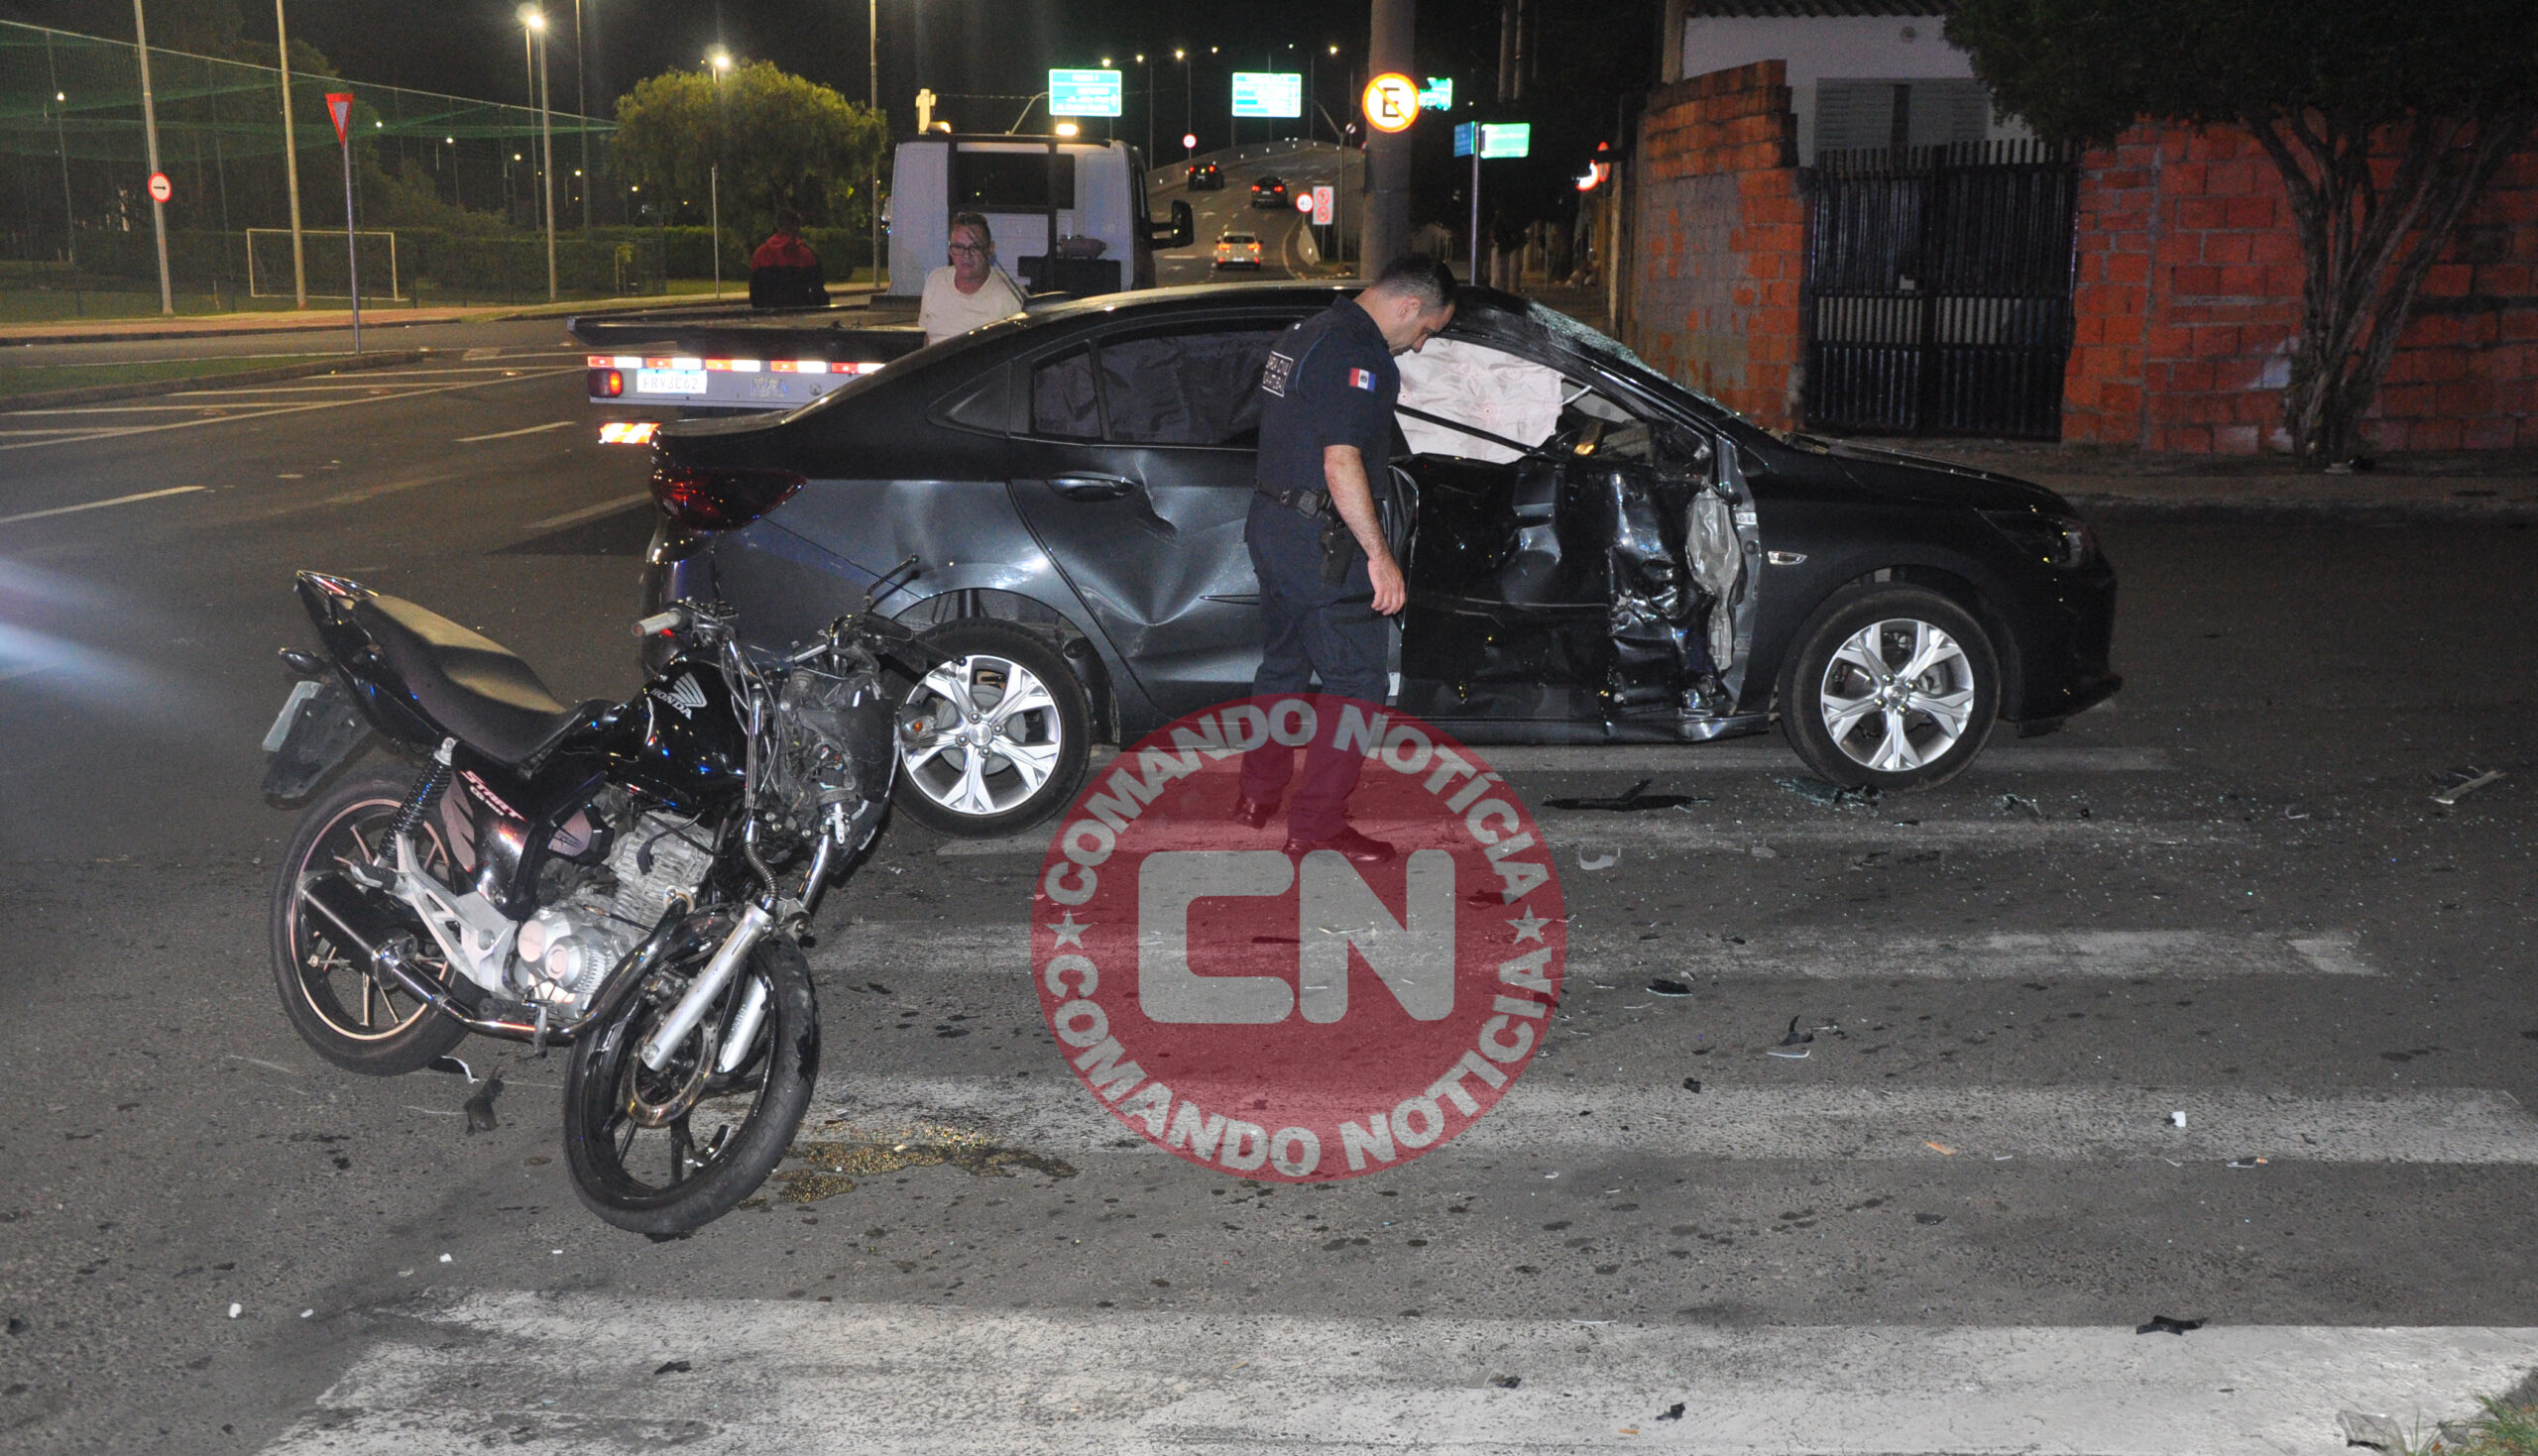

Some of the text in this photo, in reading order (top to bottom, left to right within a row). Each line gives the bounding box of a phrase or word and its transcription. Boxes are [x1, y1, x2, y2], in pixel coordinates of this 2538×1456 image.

[1383, 87, 1400, 117] E
[650, 688, 692, 720] HONDA
[459, 770, 527, 822] START
